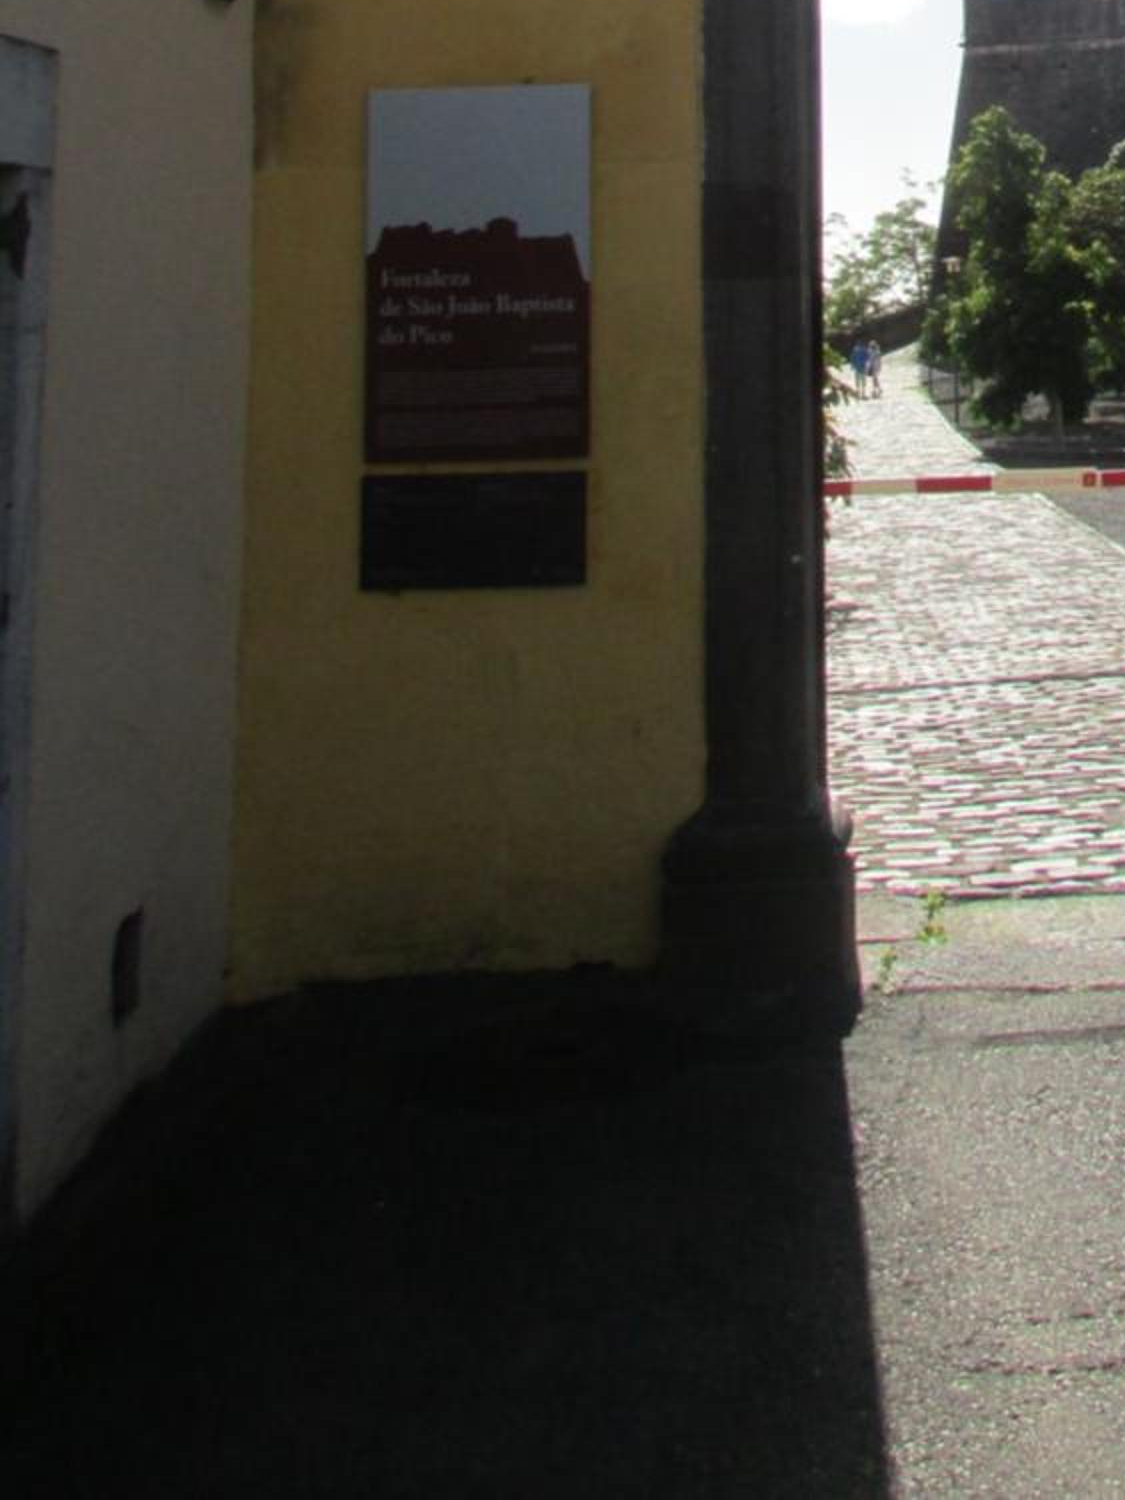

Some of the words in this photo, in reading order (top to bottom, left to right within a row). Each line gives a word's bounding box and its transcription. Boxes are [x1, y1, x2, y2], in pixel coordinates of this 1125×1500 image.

[380, 267, 470, 289] Fortaleza
[379, 295, 401, 317] de
[407, 294, 443, 316] São
[445, 293, 491, 319] João
[496, 292, 576, 319] Baptista
[378, 324, 405, 345] do
[409, 323, 454, 345] Pico
